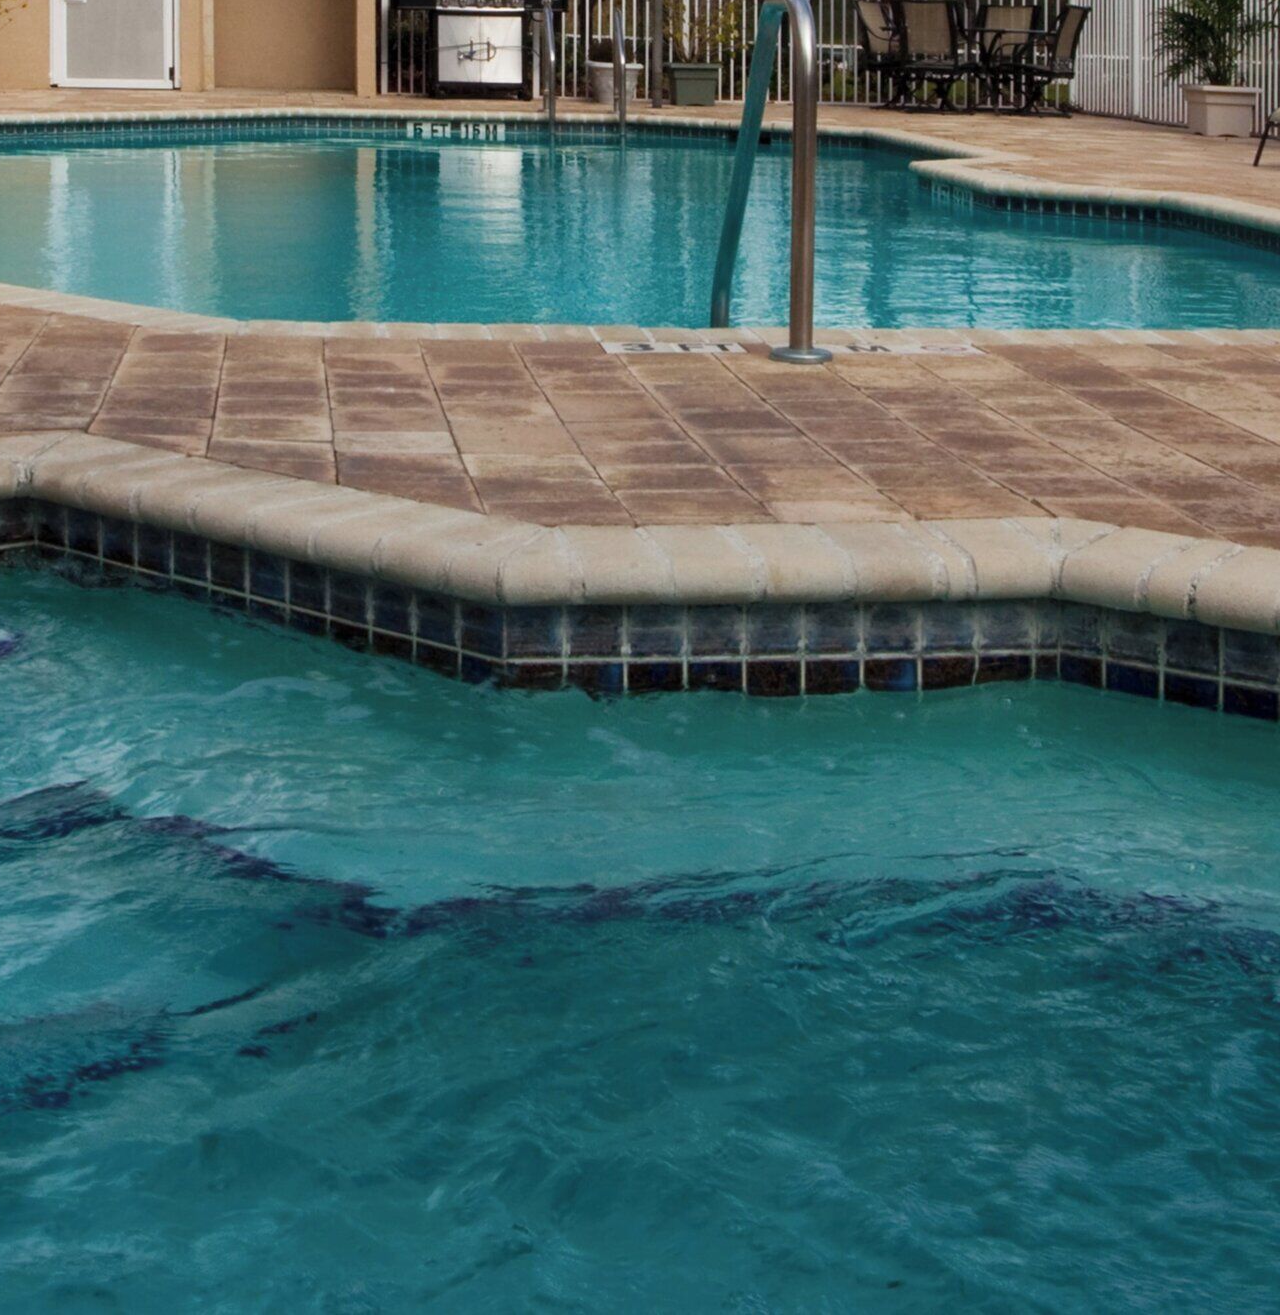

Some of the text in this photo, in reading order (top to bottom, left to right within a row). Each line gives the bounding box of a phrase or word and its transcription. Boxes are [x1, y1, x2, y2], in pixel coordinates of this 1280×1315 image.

[431, 124, 449, 139] FT
[486, 124, 498, 140] M
[620, 343, 734, 352] 3 FT
